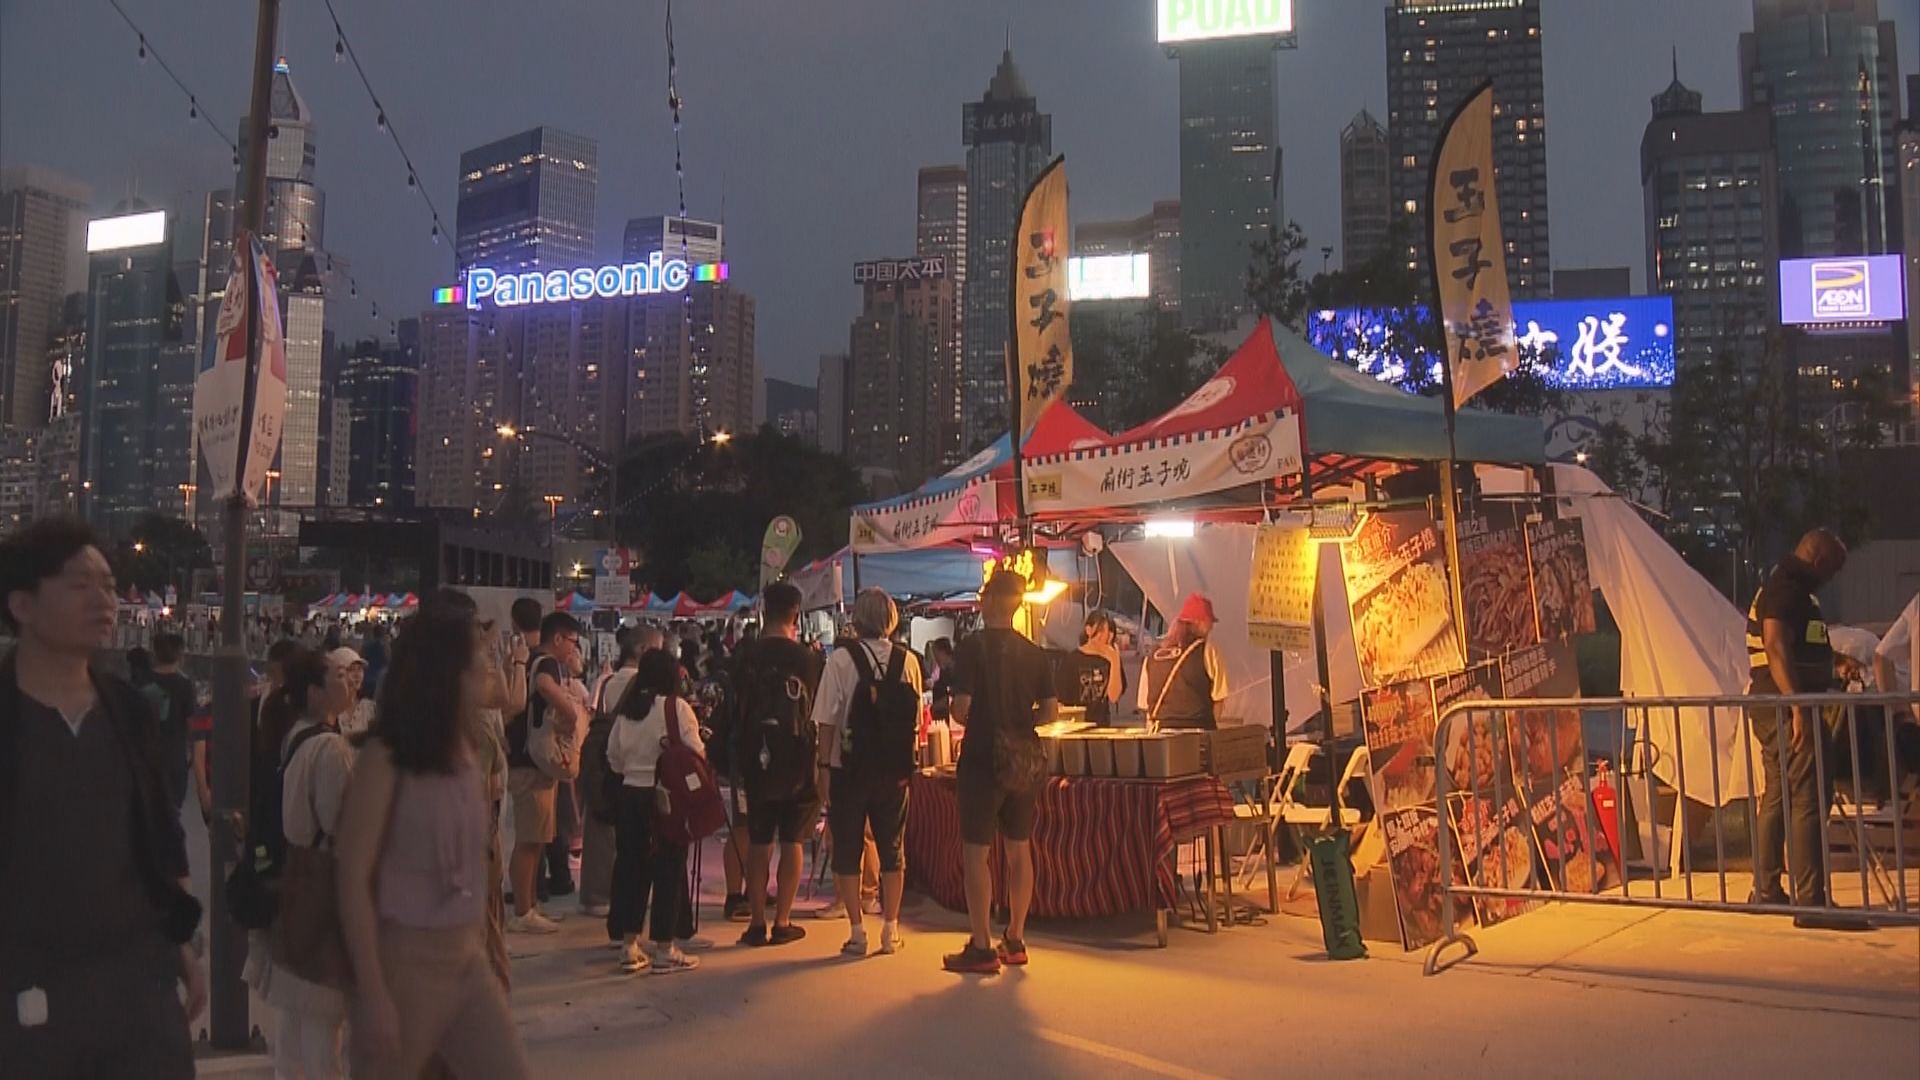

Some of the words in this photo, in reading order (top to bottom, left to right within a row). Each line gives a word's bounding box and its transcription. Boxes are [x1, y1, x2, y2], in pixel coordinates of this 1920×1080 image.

[466, 250, 689, 310] Panasonic
[855, 258, 945, 281] 中国太平
[1444, 168, 1507, 362] 玉子燒
